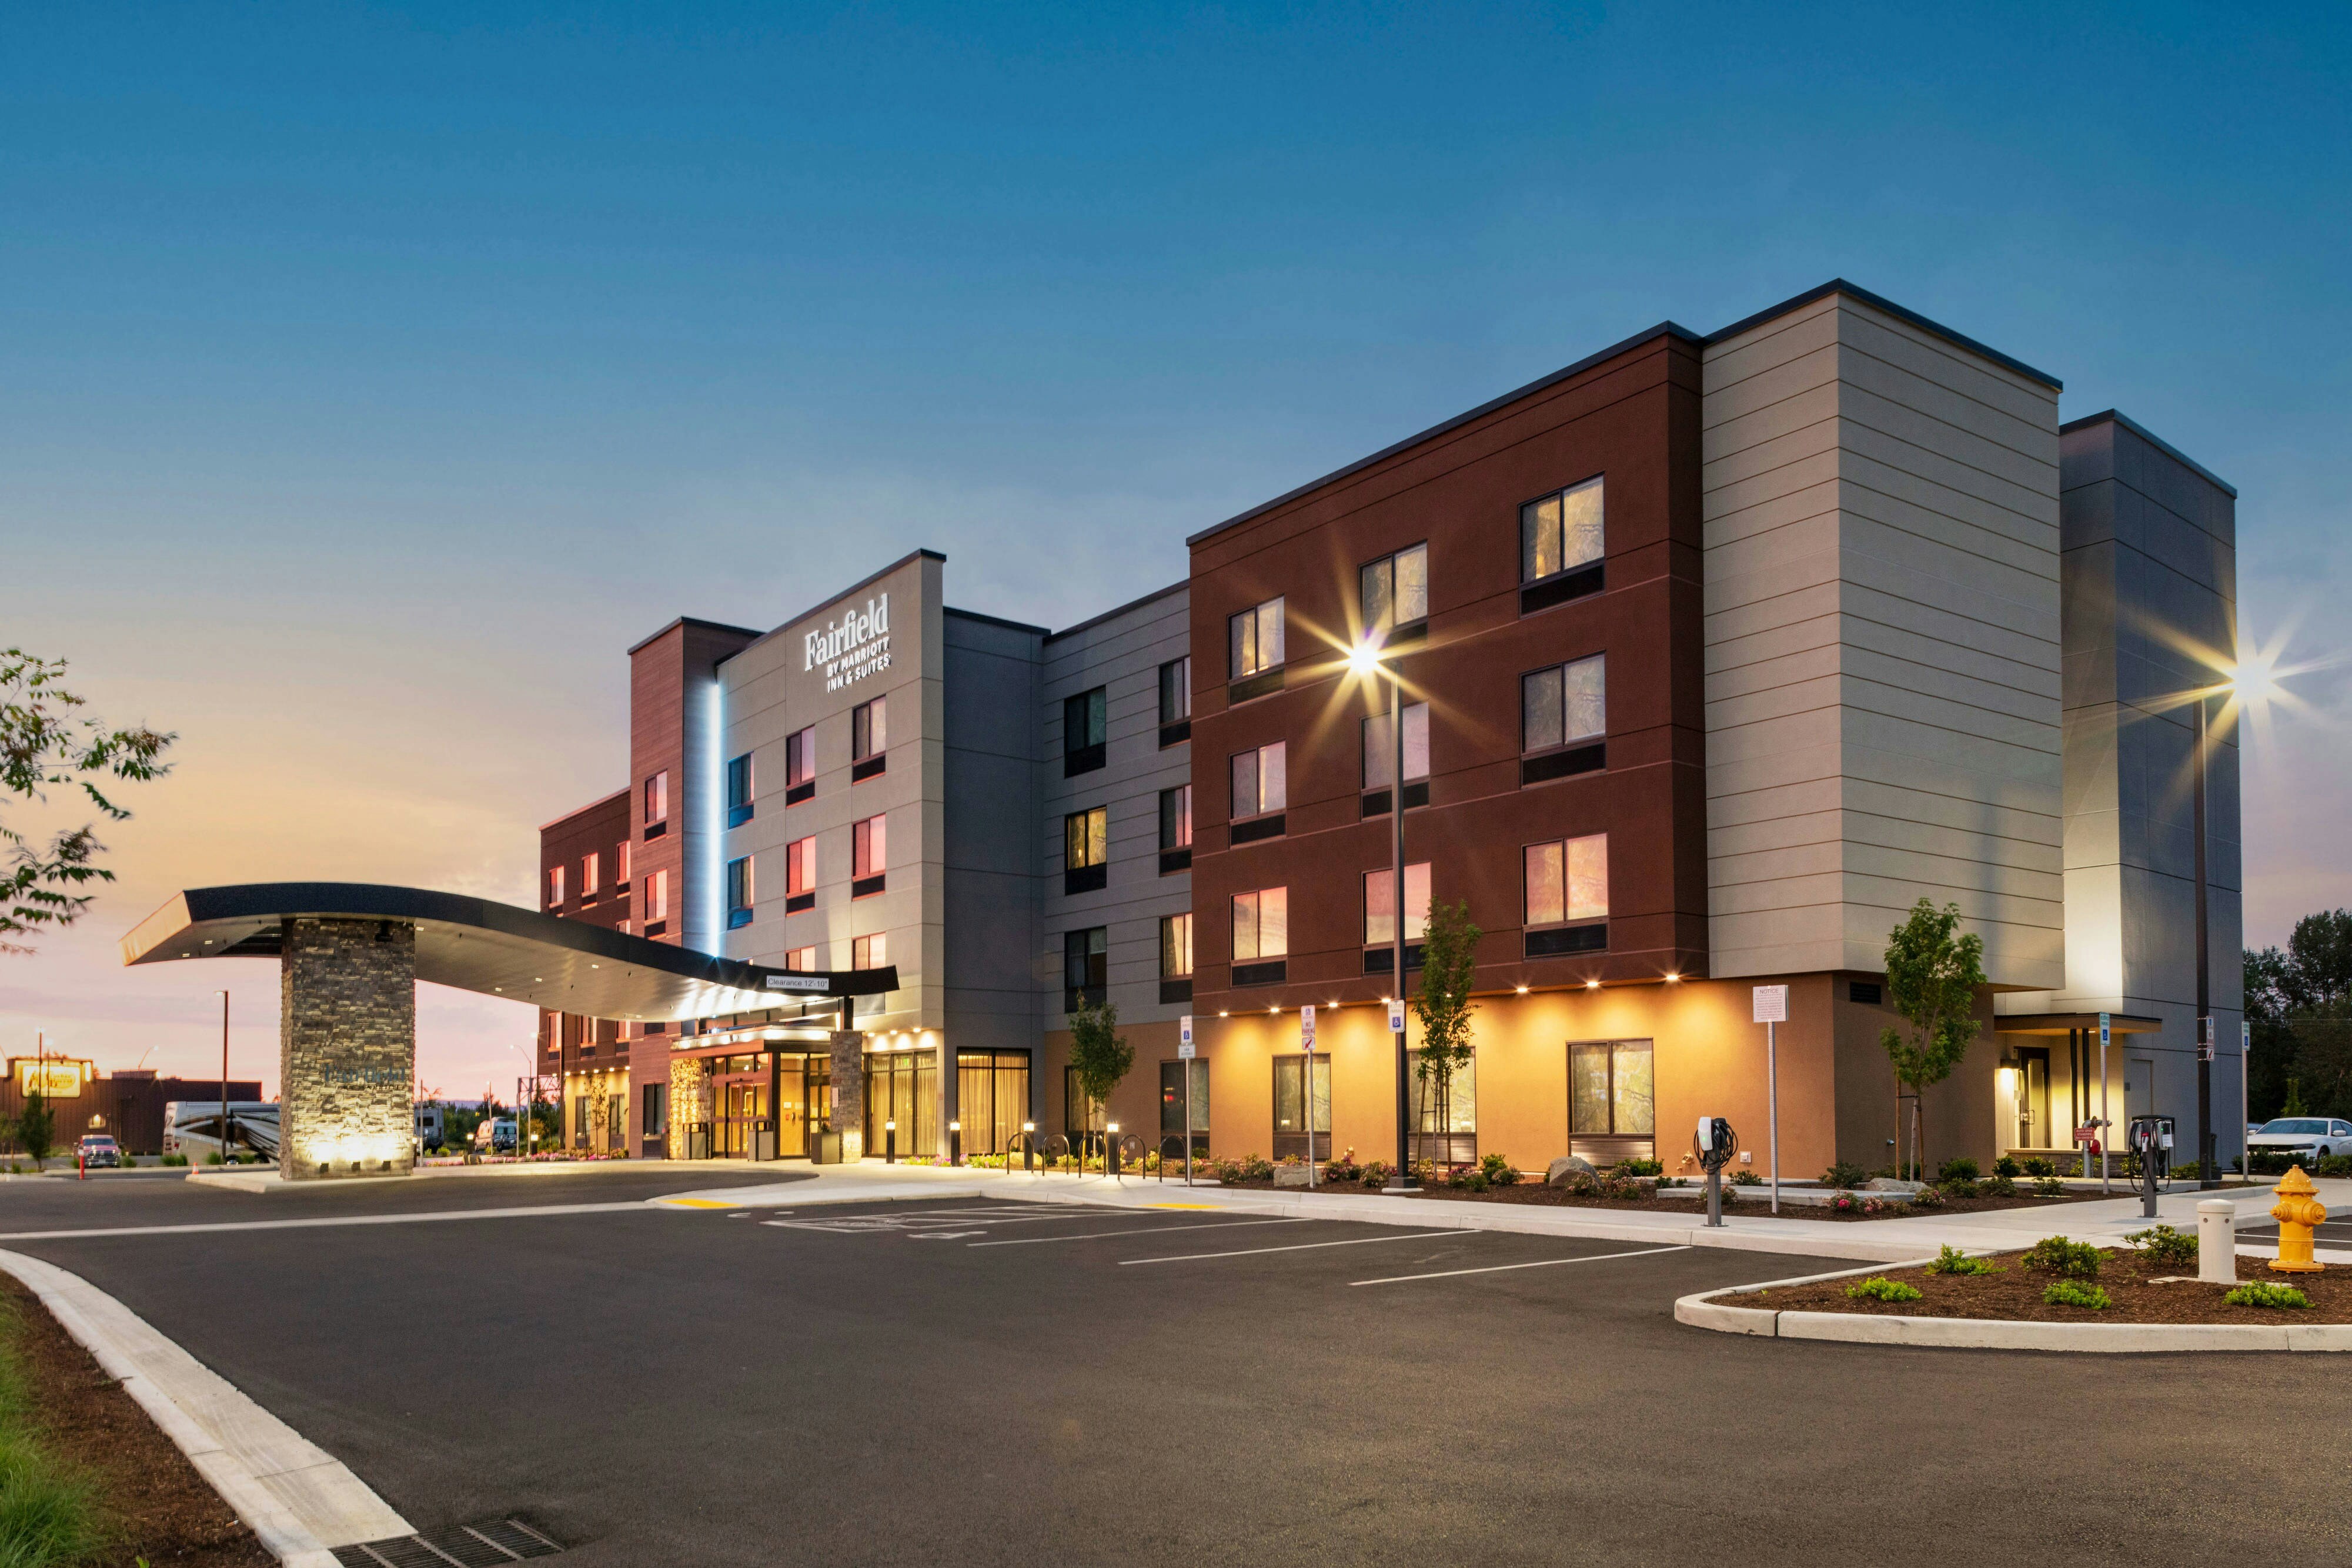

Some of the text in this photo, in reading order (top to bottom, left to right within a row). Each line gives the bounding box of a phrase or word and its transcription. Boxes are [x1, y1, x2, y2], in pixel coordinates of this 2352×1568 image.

[805, 593, 889, 671] Fairfield
[827, 636, 890, 677] BY MARRIOTT
[827, 653, 891, 693] INN & SUITES
[768, 978, 802, 986] Clearance
